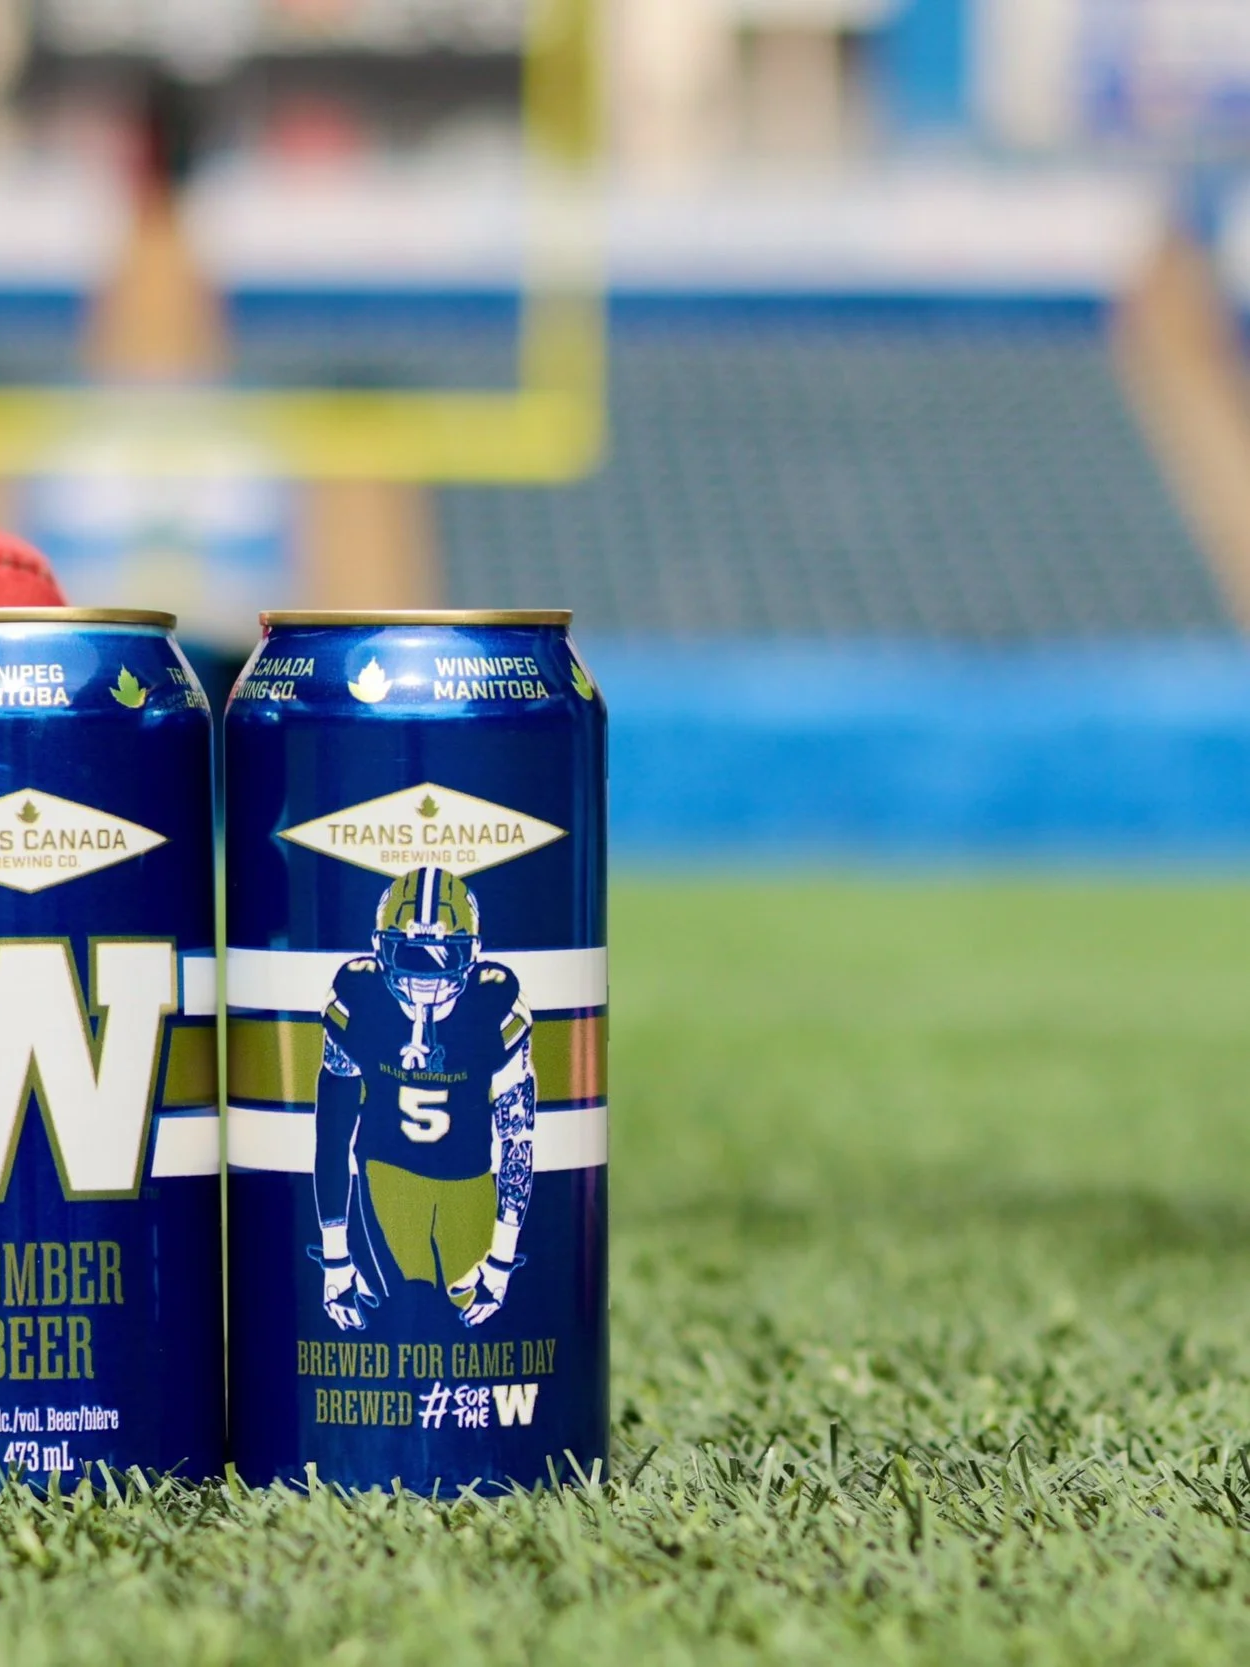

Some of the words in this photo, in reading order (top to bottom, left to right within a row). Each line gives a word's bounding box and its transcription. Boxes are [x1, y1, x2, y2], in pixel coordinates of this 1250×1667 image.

[434, 656, 539, 677] WINNIPEG
[269, 680, 298, 700] CO.
[433, 679, 550, 700] MANITOBA
[23, 828, 127, 851] CANADA
[327, 824, 414, 846] TRANS
[422, 823, 526, 845] CANADA
[57, 854, 82, 868] CO.
[380, 849, 452, 864] BREWING
[456, 849, 481, 863] CO.
[379, 1062, 409, 1082] BLUE
[398, 1085, 451, 1143] 5
[297, 1340, 390, 1378] BREWED
[397, 1343, 445, 1379] FOR
[451, 1340, 515, 1378] GAME
[521, 1338, 557, 1375] DAY
[46, 1404, 120, 1433] Beer/bière
[315, 1387, 413, 1427] BREWED
[3, 1440, 40, 1472] 473
[42, 1440, 75, 1472] mL
